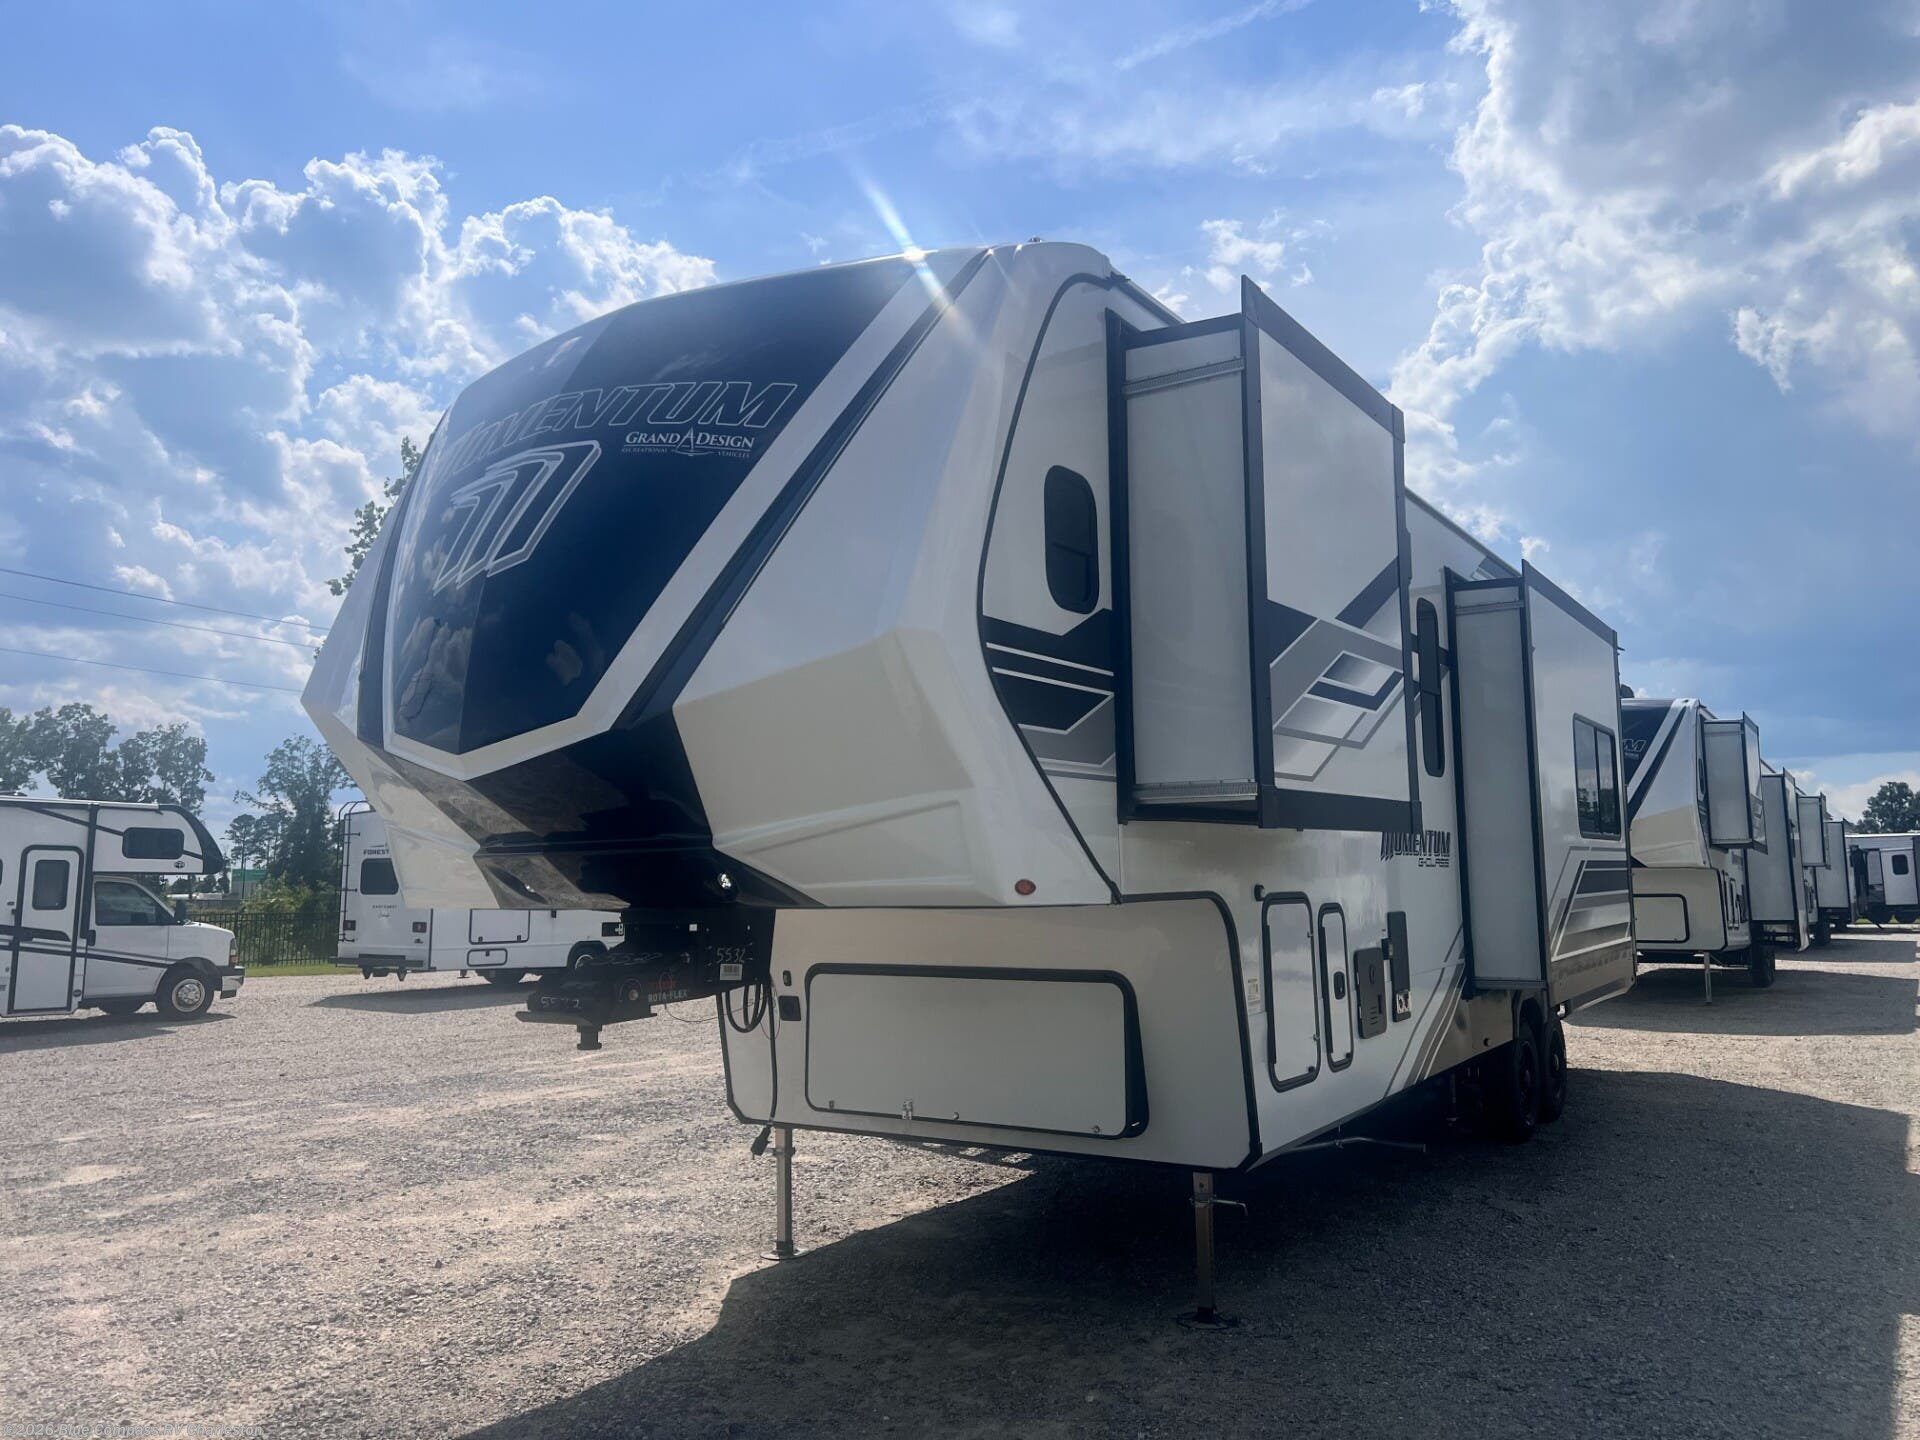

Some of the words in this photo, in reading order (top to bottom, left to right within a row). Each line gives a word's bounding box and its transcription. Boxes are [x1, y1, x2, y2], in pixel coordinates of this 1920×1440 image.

[625, 431, 681, 444] GRAND
[696, 432, 755, 448] DESIGN
[648, 989, 689, 1003] ROTA-FLEX
